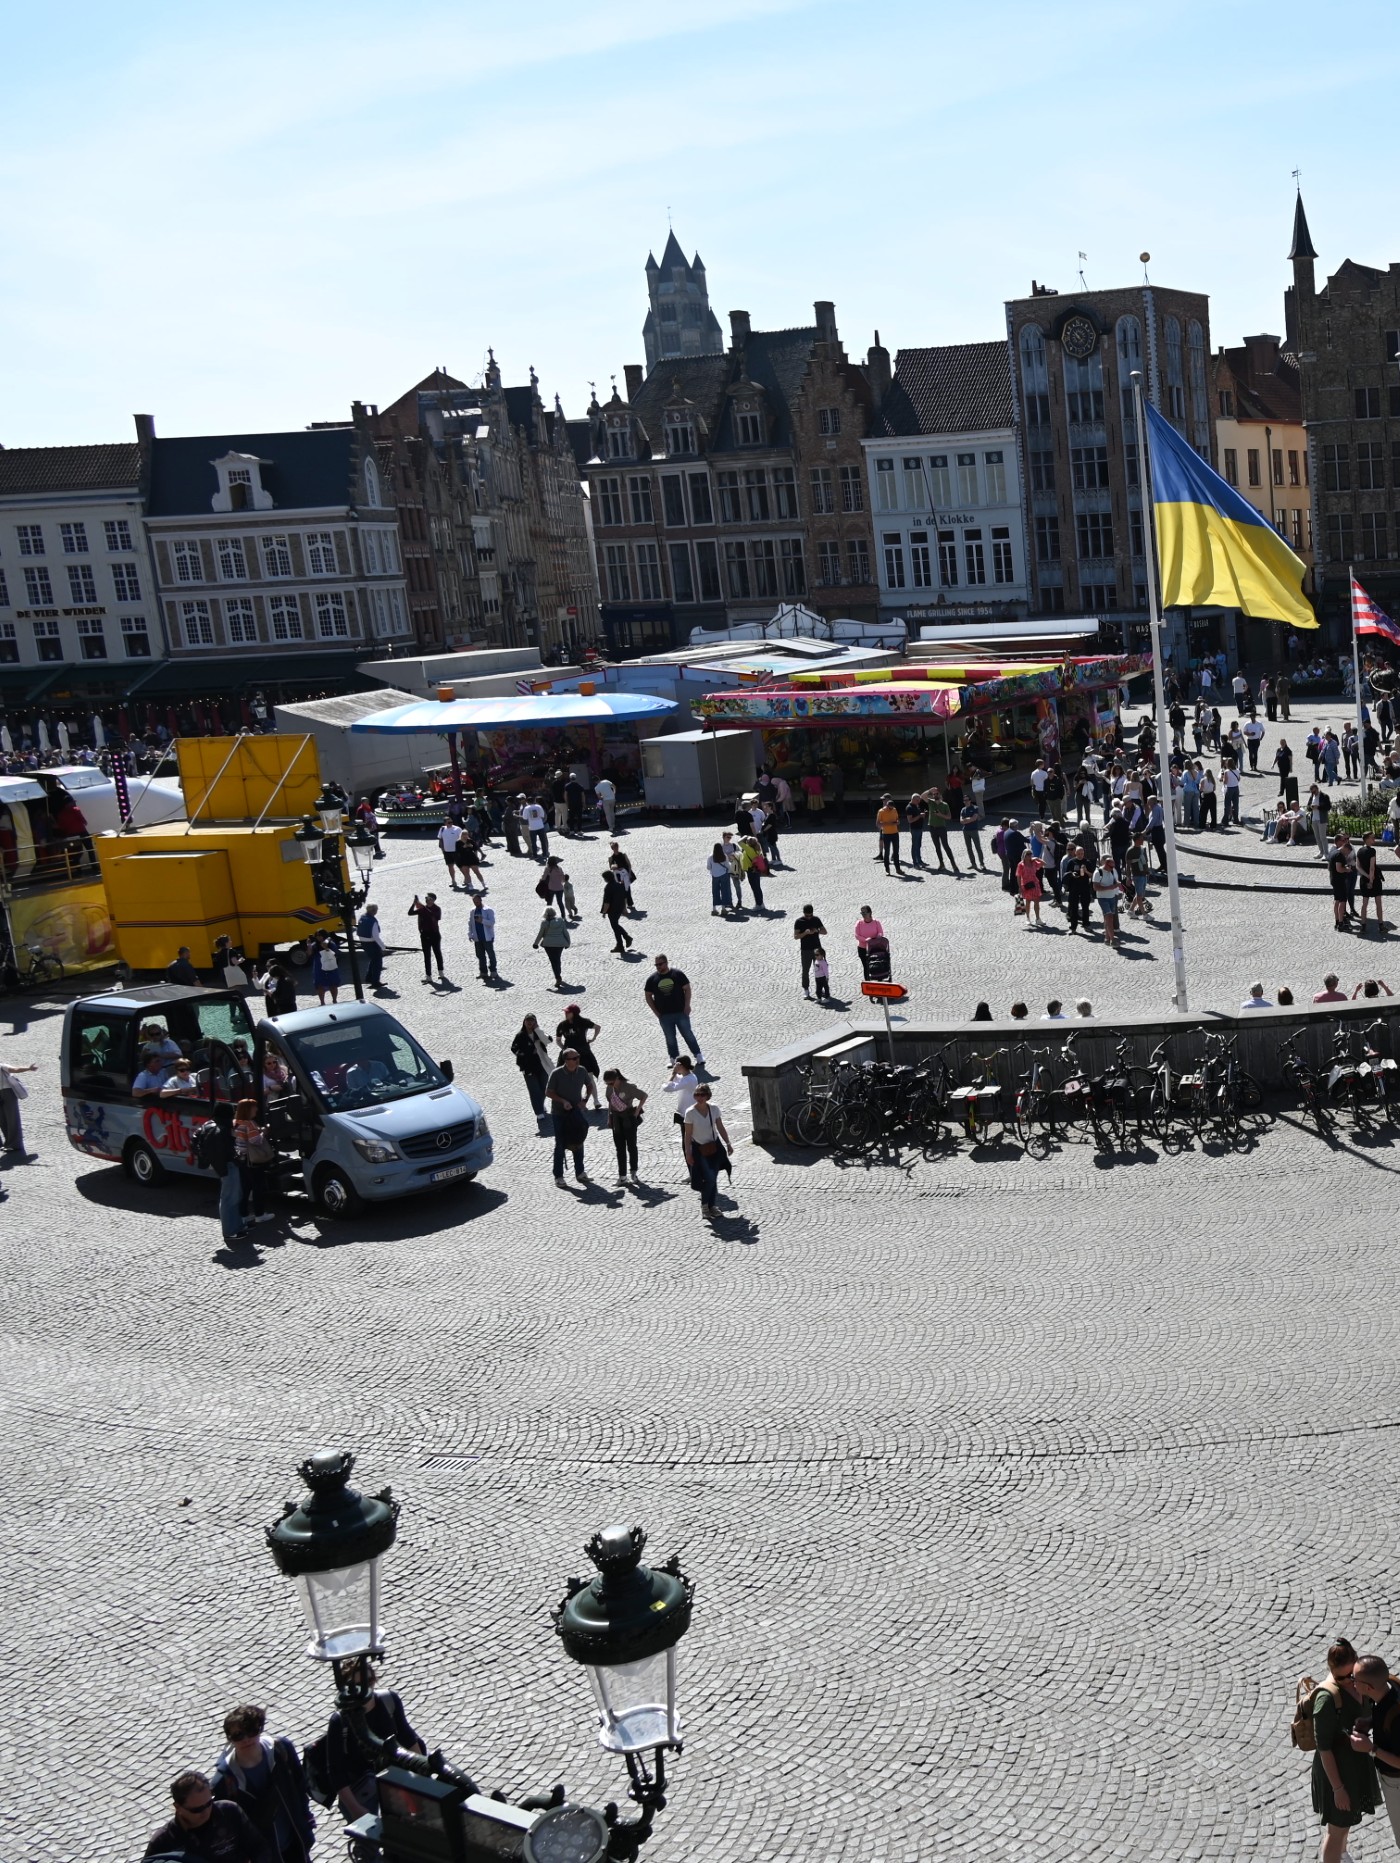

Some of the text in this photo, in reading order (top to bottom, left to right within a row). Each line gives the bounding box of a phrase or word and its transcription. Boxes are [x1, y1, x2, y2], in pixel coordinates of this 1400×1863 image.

[913, 514, 975, 527] in de Klokke
[16, 606, 106, 618] DE VIER WINDEN
[906, 606, 993, 619] FLAME GRILLING SINCE 1954
[143, 1106, 194, 1166] City
